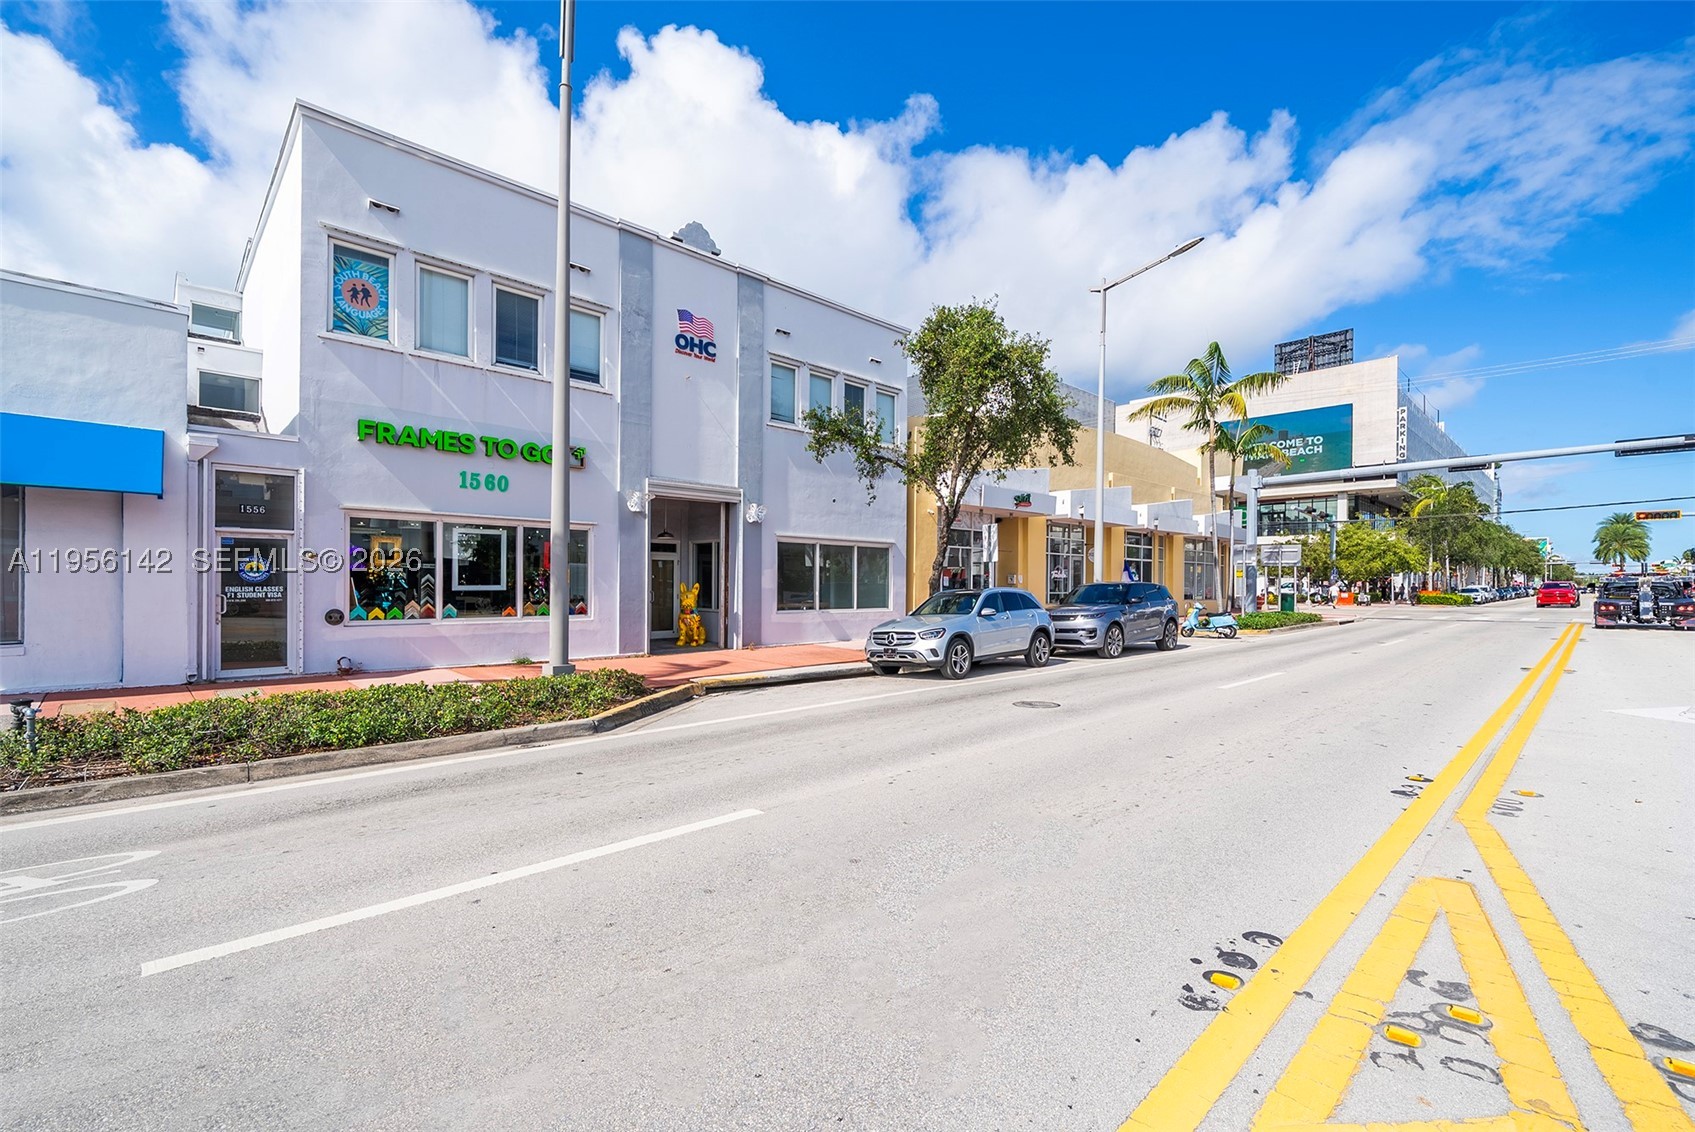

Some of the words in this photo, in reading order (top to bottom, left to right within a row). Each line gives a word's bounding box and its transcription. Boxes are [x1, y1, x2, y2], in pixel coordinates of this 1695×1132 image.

[335, 271, 360, 289] SOUTH
[362, 272, 387, 302] BEACH
[334, 296, 386, 319] LANGUAGES
[675, 334, 716, 358] OHC
[358, 418, 476, 454] FRAMES
[480, 435, 519, 460] TO
[1306, 436, 1324, 445] TO
[1282, 445, 1323, 457] BEACH
[459, 470, 510, 492] 1560
[240, 504, 266, 514] 1556
